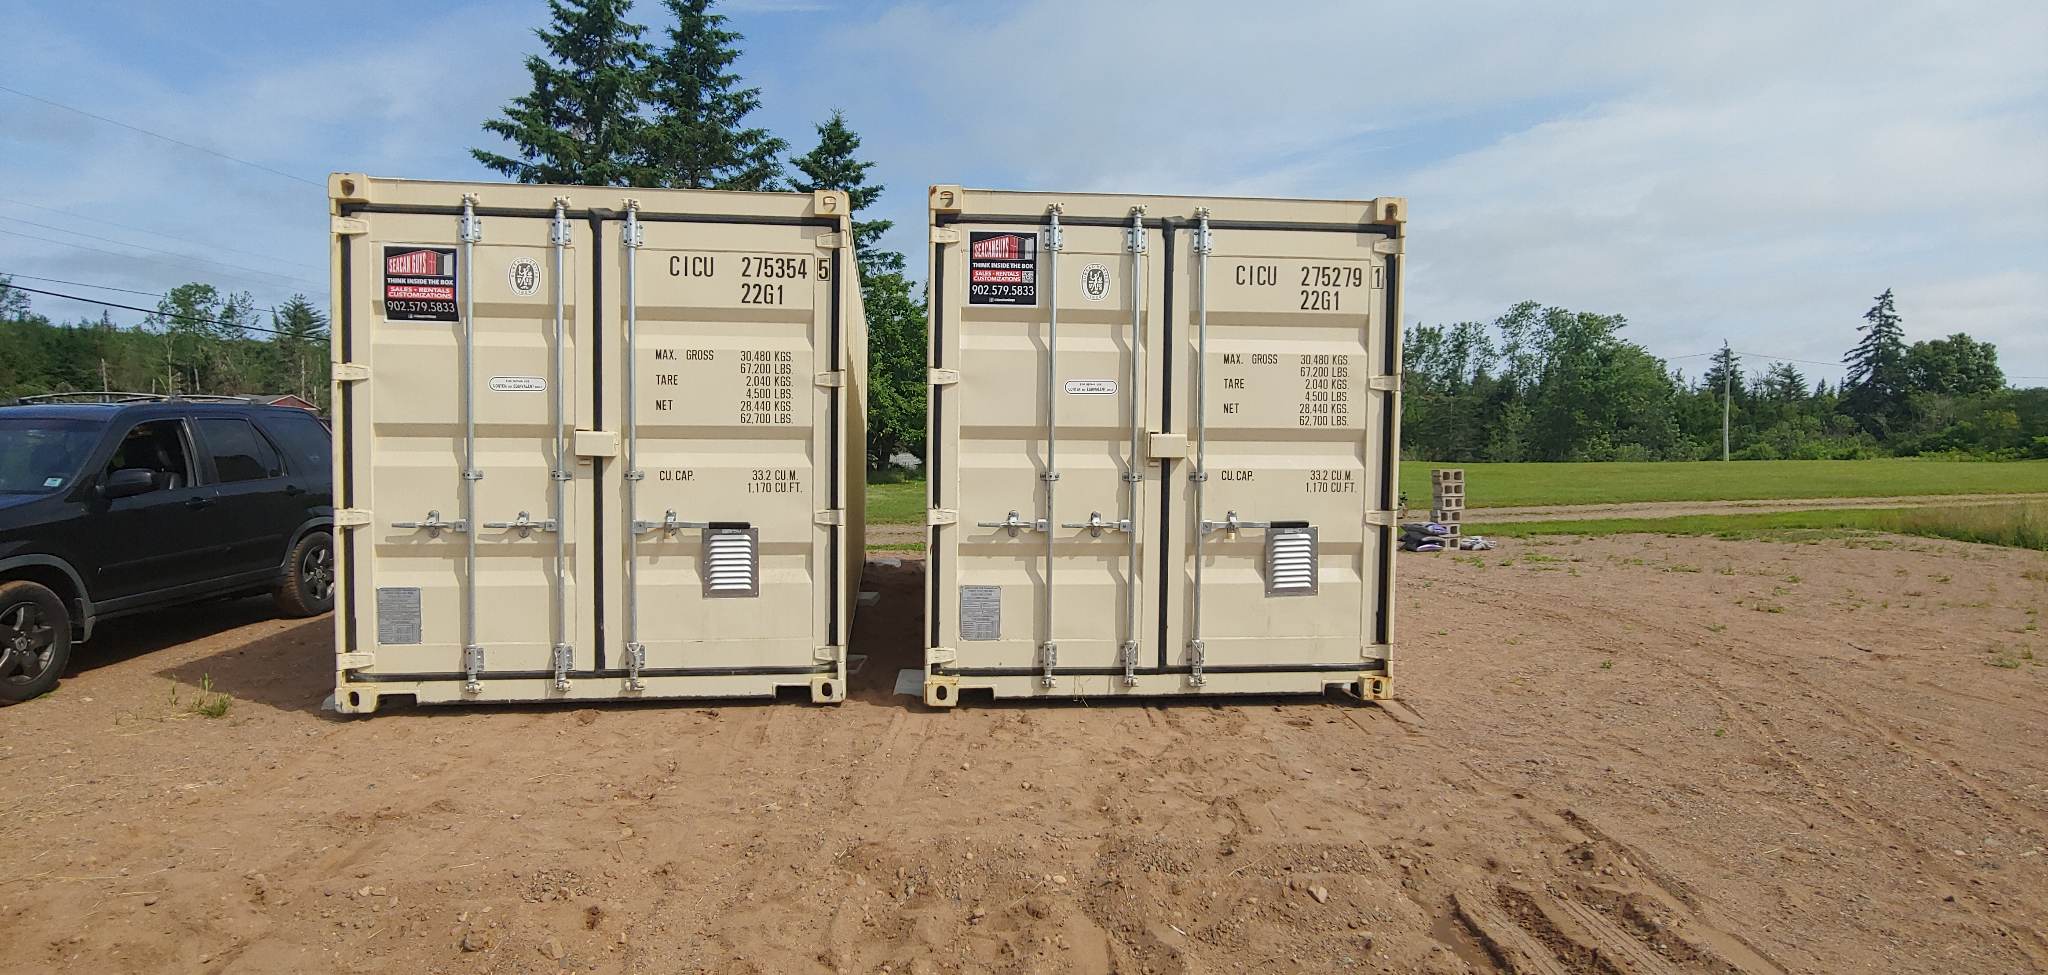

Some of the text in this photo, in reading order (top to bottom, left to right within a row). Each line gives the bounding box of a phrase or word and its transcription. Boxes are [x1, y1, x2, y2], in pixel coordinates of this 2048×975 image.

[389, 256, 410, 273] SEACAN
[669, 256, 829, 279] CICU 275354 5
[1236, 265, 1380, 287] CICU 275279 1
[741, 283, 783, 304] 22G1
[972, 285, 1034, 295] 902.579.5833
[1300, 290, 1339, 310] 22G1
[387, 301, 454, 312] 902.579.5833
[656, 350, 677, 360] MAX.
[686, 350, 714, 360] GROSS
[774, 351, 794, 362] KGS.
[1224, 354, 1243, 364] MAX.
[1252, 354, 1278, 364] GROSS
[774, 364, 794, 375] LBS.
[1332, 367, 1349, 378] LBS.
[656, 375, 678, 385] TARE
[774, 376, 794, 387] KGS.
[1224, 379, 1244, 389] TARE
[1332, 379, 1349, 390] KGS.
[774, 389, 794, 400] LBS.
[1332, 392, 1349, 402] LBS.
[656, 400, 673, 410] NET
[774, 401, 794, 412] KGS.
[1224, 403, 1239, 414] NET
[1332, 404, 1349, 414] KGS.
[774, 414, 794, 424] LBS.
[1332, 416, 1349, 426] LBS.
[752, 470, 771, 481] 33.2
[1310, 470, 1328, 480] 33.2
